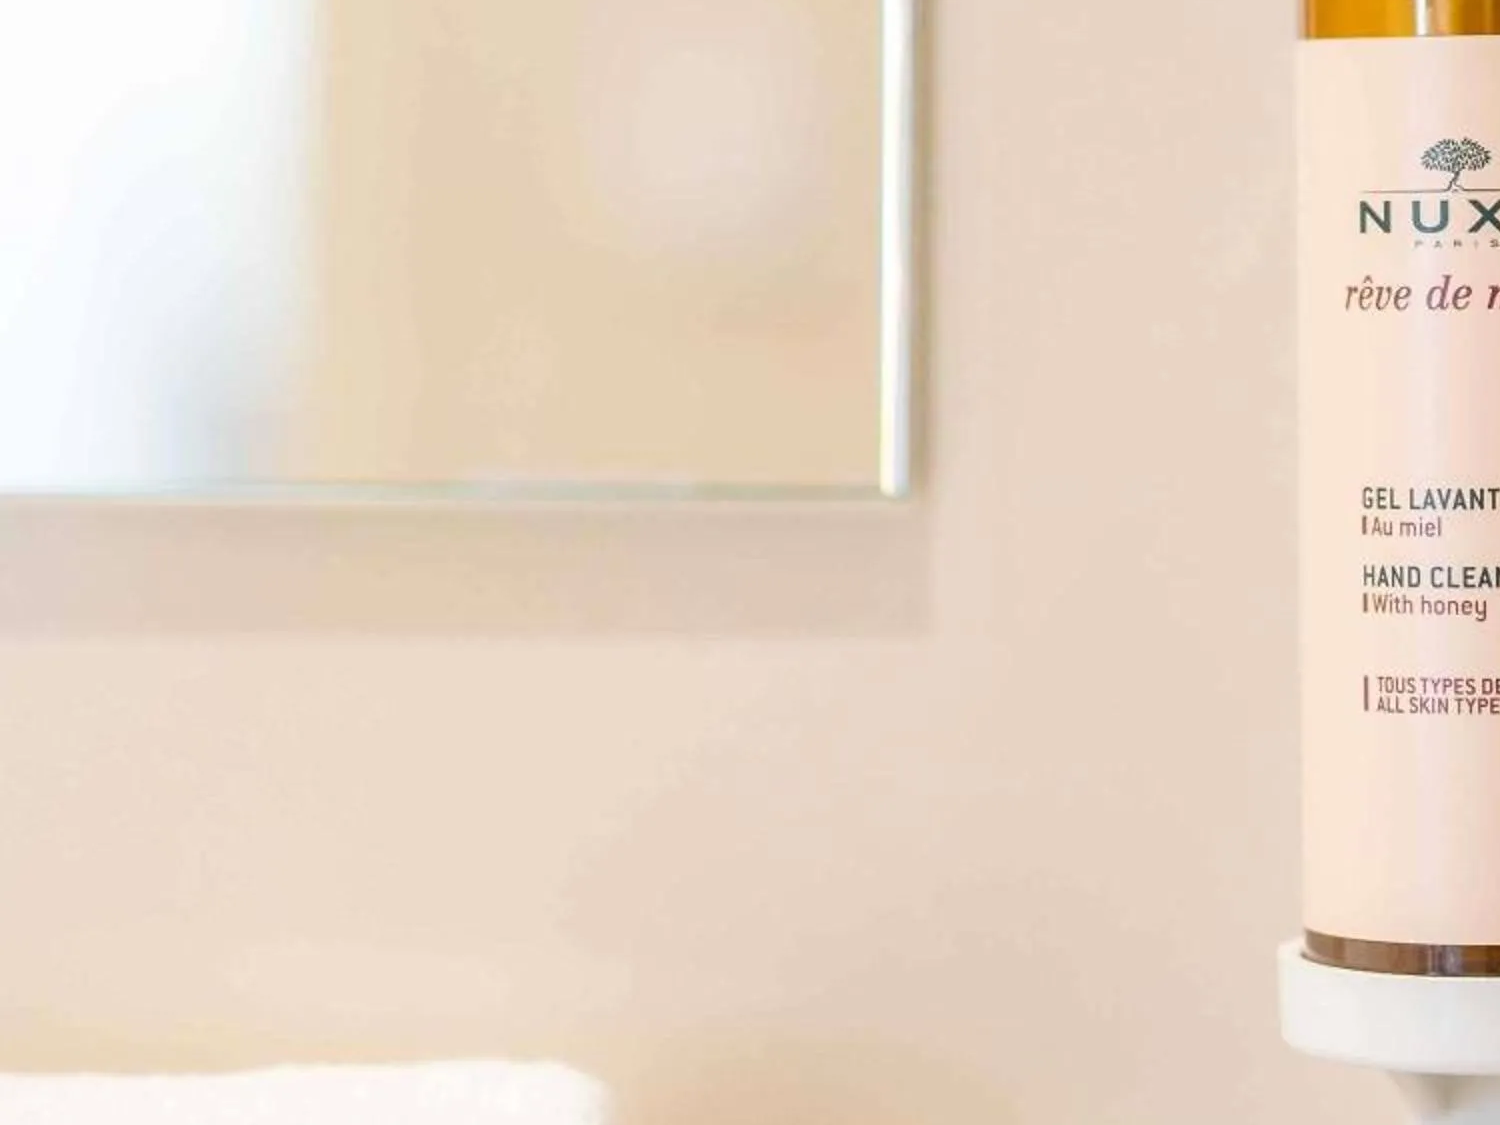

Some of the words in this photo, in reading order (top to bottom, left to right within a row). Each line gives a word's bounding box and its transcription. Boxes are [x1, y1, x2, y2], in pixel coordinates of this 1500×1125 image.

[1344, 274, 1412, 311] rêve
[1426, 275, 1473, 311] de
[1362, 487, 1401, 510] GEL
[1409, 488, 1500, 510] LAVANT
[1371, 517, 1393, 536] Au
[1399, 517, 1442, 538] miel
[1363, 565, 1421, 588] HAND
[1372, 594, 1413, 614] With
[1421, 595, 1487, 621] honey
[1377, 676, 1416, 695] TOUS
[1420, 677, 1476, 695] TYPES
[1376, 698, 1402, 714] ALL
[1409, 698, 1449, 714] SKIN
